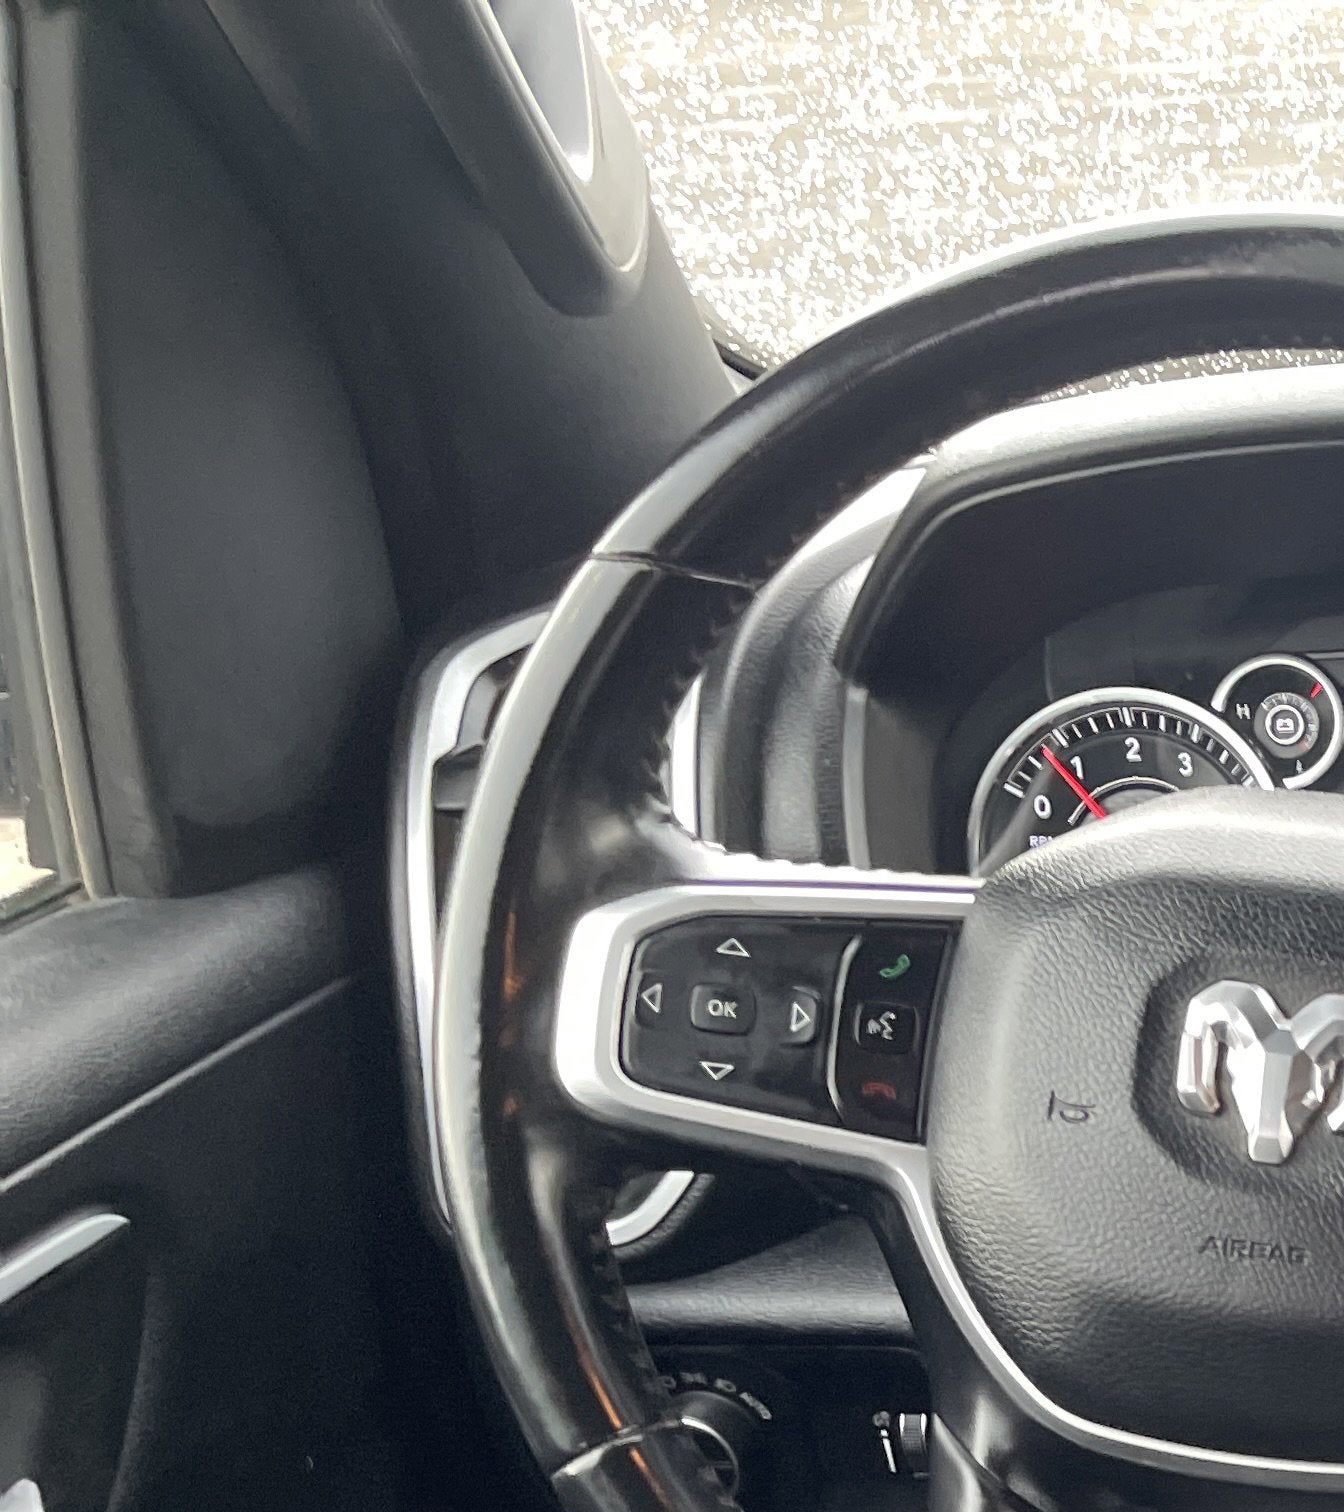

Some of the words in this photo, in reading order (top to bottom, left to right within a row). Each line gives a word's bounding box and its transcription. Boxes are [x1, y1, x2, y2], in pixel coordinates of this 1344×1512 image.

[1235, 703, 1251, 719] H
[1124, 736, 1143, 763] 2
[1070, 755, 1084, 780] 1
[1177, 752, 1194, 777] 3
[1033, 794, 1052, 819] 0
[705, 999, 739, 1020] OK
[1198, 1236, 1308, 1264] AIRBAG
